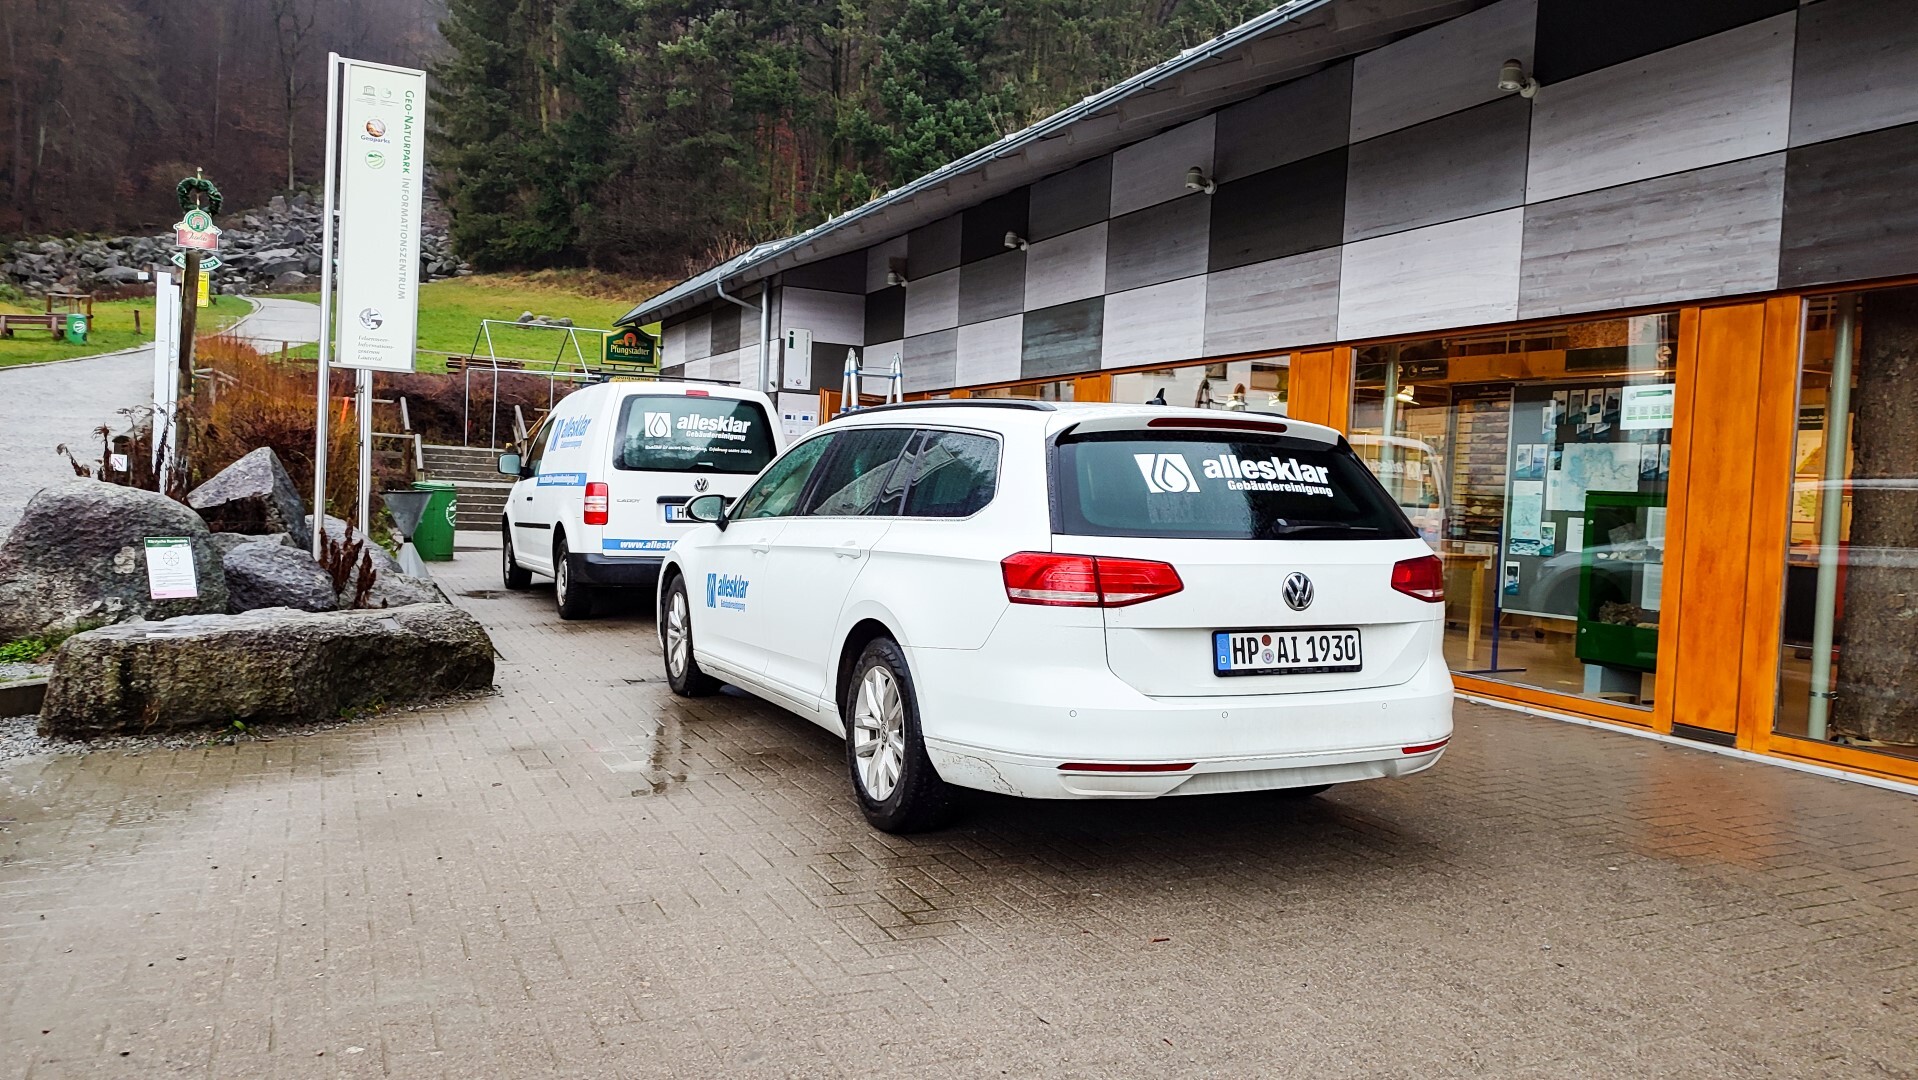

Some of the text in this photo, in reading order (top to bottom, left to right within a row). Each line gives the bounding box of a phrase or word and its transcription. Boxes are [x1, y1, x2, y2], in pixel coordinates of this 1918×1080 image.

[397, 90, 414, 300] GEO-NATURPARK INFORMATIONSZENTRUM
[610, 344, 650, 356] Pfungstädter
[676, 413, 752, 434] allesklar
[685, 430, 746, 441] Gebäudereinigung
[1202, 454, 1329, 484] allesklar
[1227, 480, 1334, 497] Gebäudereinigung
[717, 574, 749, 598] allesklar
[1232, 637, 1259, 664] HP
[1277, 636, 1301, 663] AI
[1306, 635, 1356, 663] 1930
